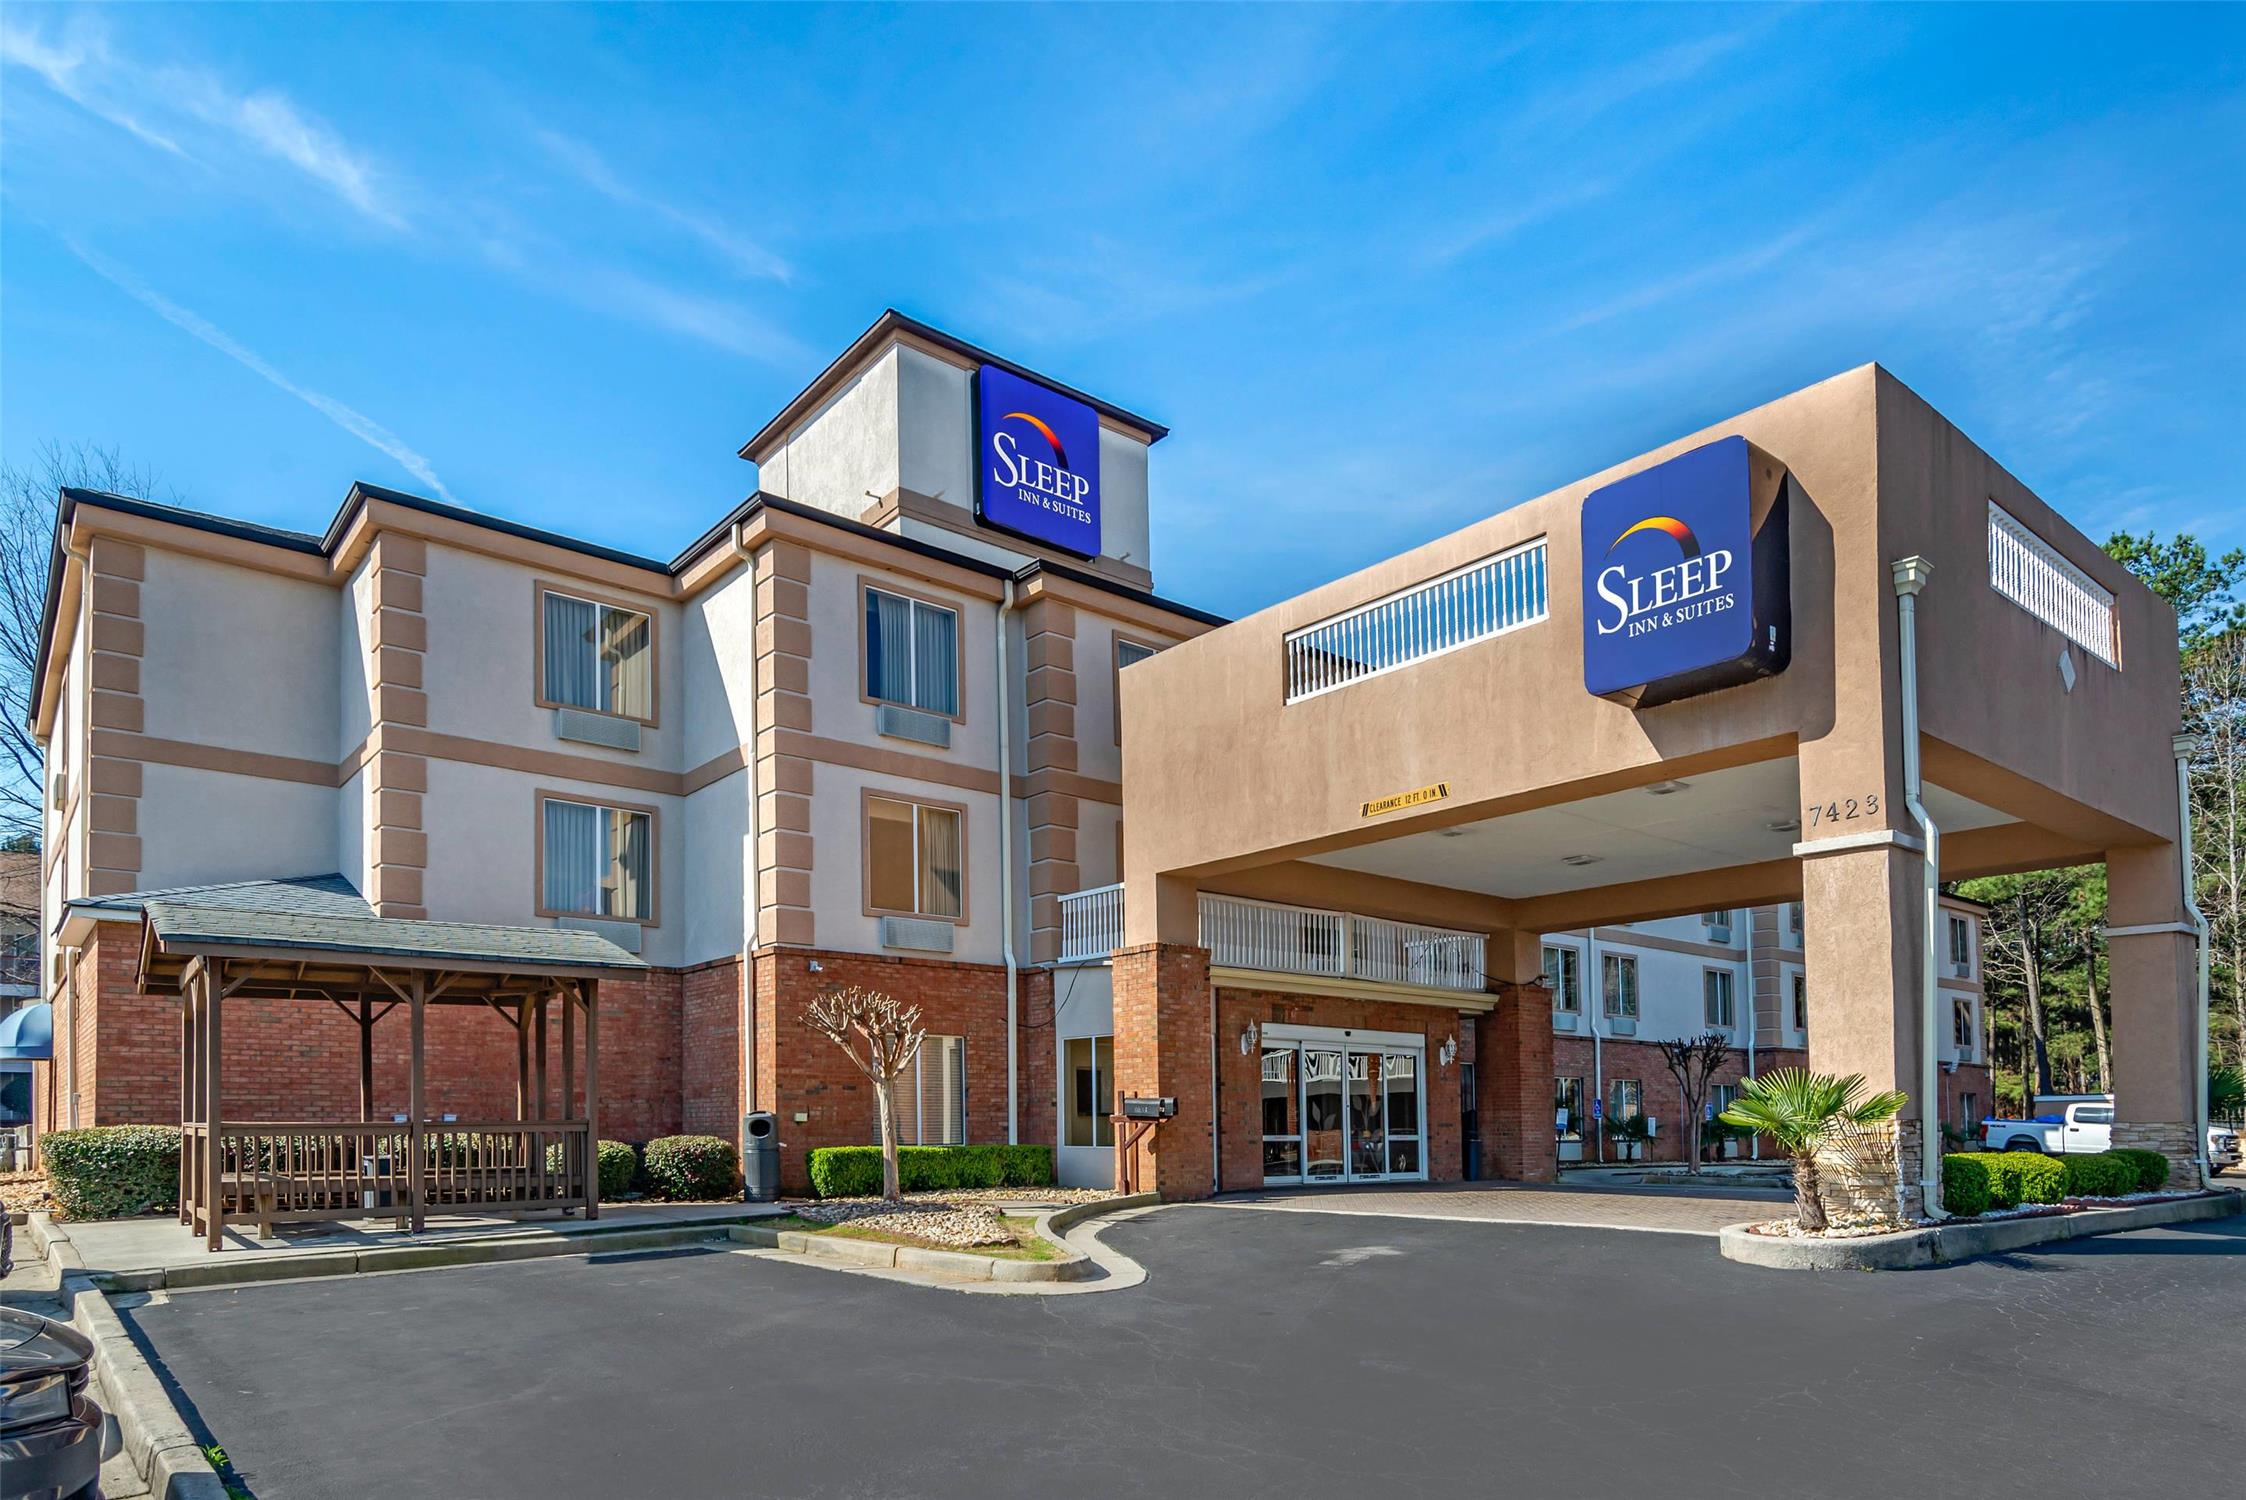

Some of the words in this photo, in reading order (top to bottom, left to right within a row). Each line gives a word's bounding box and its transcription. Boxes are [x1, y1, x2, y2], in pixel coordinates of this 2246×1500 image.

[993, 432, 1089, 505] SLEEP
[1018, 488, 1040, 505] INN
[1042, 497, 1051, 510] &
[1053, 501, 1092, 524] SUITES
[1597, 550, 1733, 635] SLEEP
[1629, 616, 1658, 637] INN
[1661, 612, 1673, 627] &
[1676, 594, 1735, 624] SUITES
[1369, 797, 1401, 813] CLEARANCE
[1405, 794, 1412, 804] 12
[1809, 794, 1879, 827] 7423
